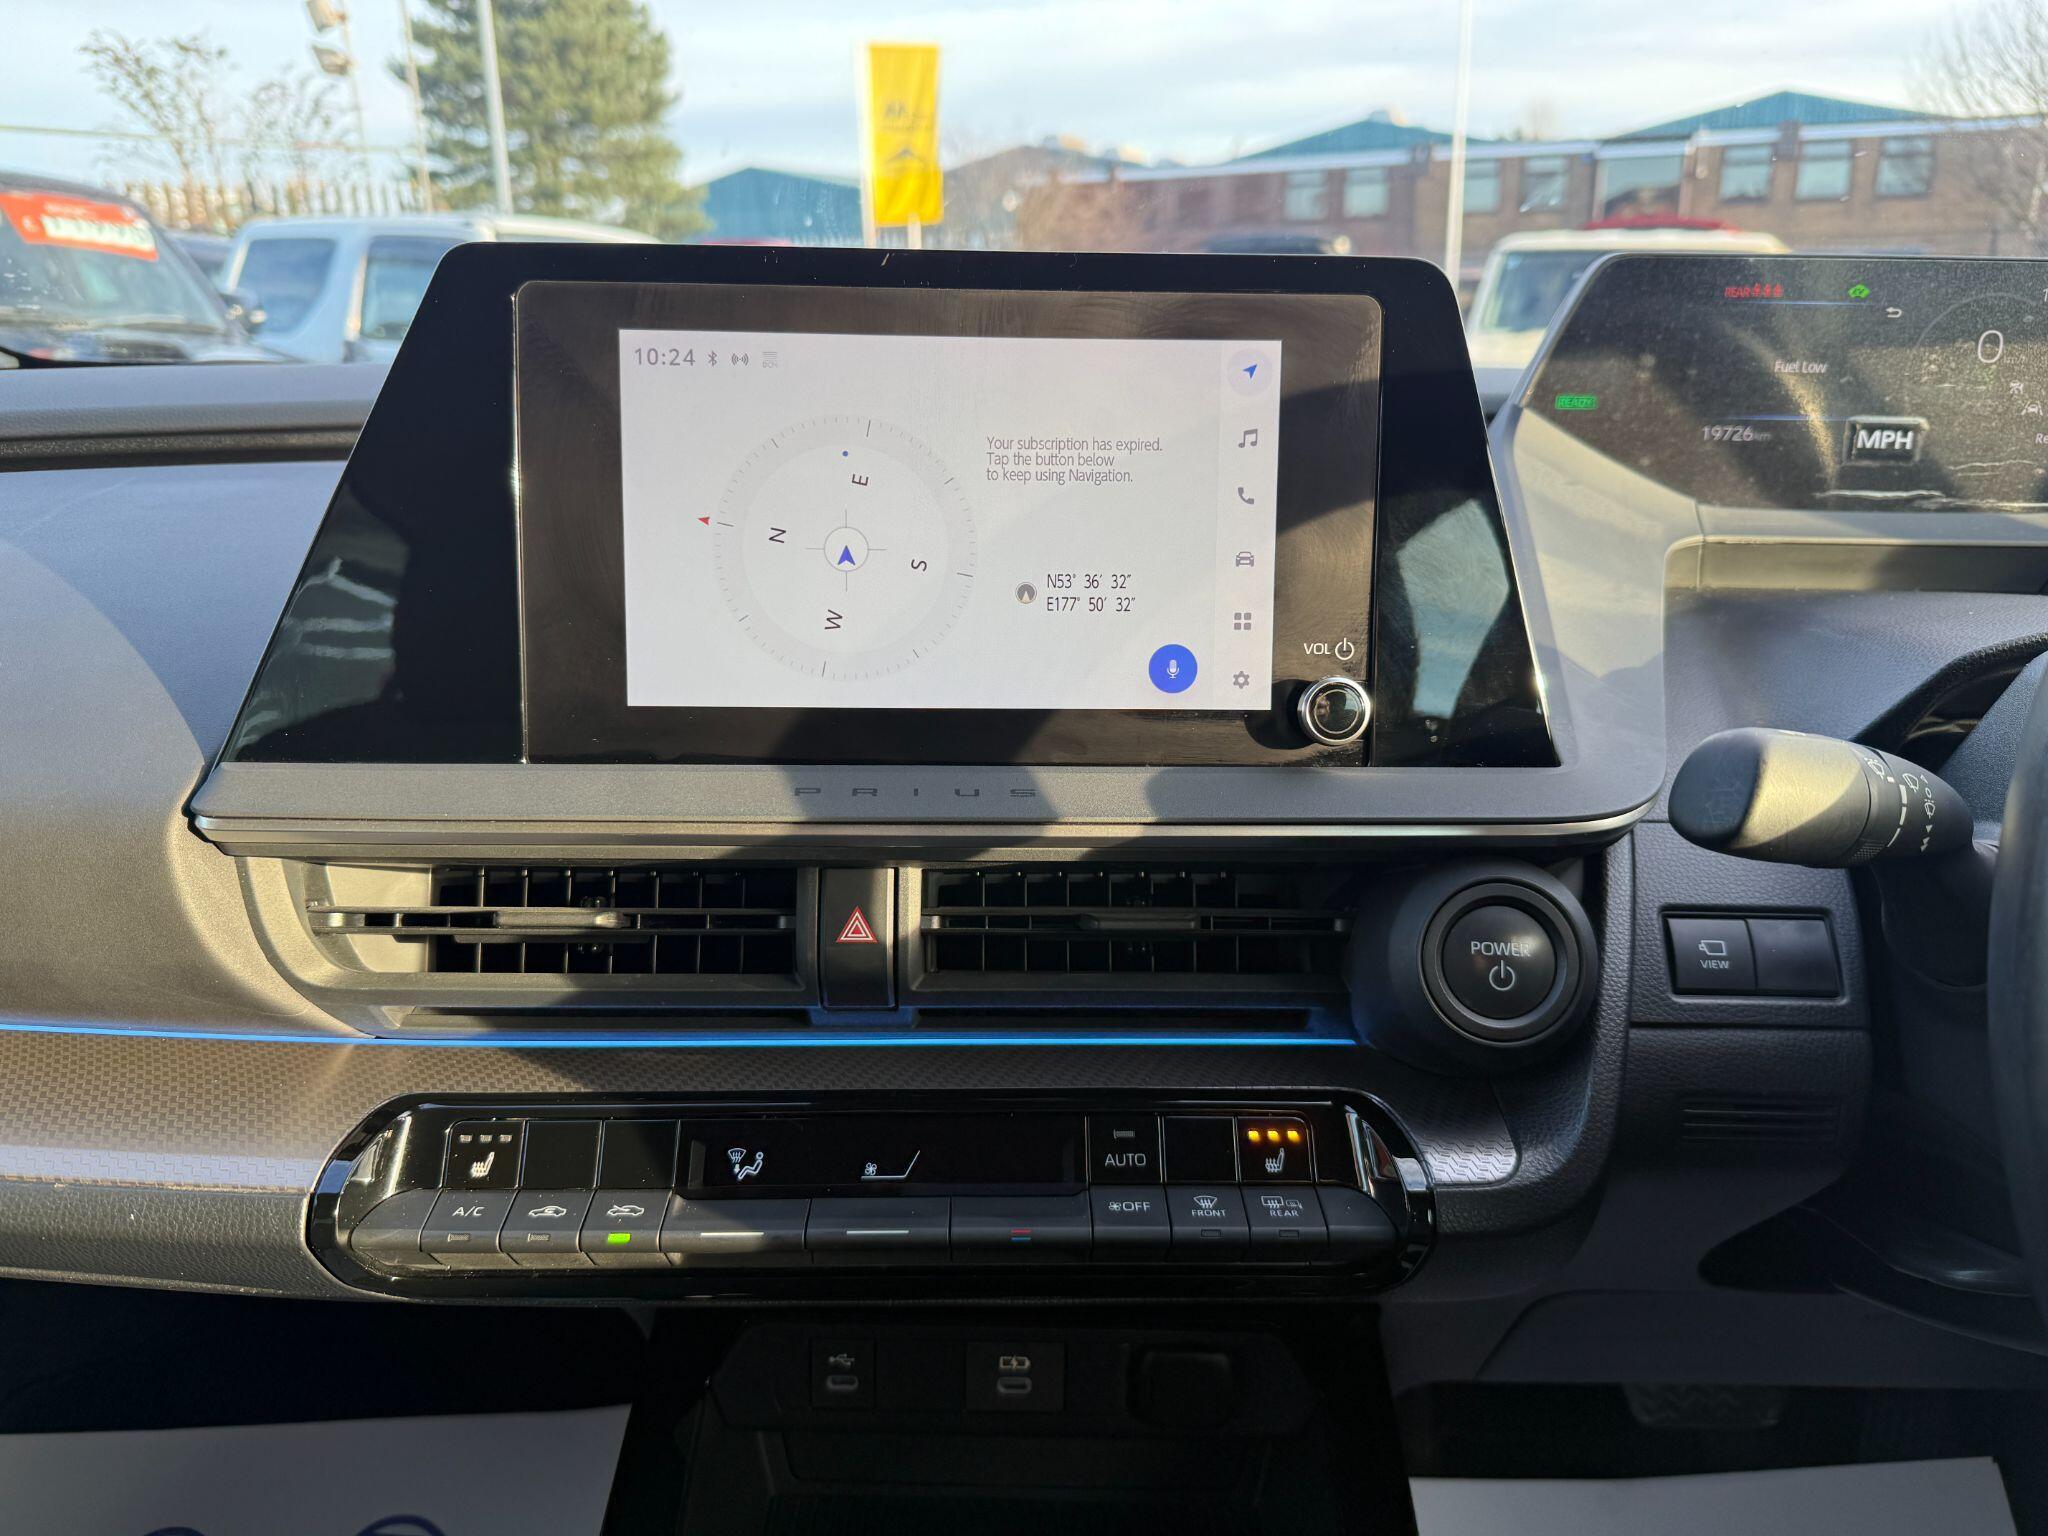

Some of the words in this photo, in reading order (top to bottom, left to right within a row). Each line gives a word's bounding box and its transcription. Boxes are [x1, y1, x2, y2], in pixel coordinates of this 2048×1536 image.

[1724, 286, 1750, 298] REAR
[1978, 330, 2003, 363] 0
[634, 348, 696, 366] 10:24
[1775, 360, 1800, 373] Fuel
[1801, 360, 1828, 373] Low
[986, 436, 1014, 451] Your
[1017, 437, 1088, 454] subscription
[1092, 437, 1112, 451] has
[1115, 438, 1162, 455] expired.
[1857, 429, 1914, 450] MPH
[986, 452, 1009, 469] Tap
[1013, 453, 1031, 466] the
[1035, 453, 1074, 466] button
[1077, 453, 1114, 466] below
[852, 474, 868, 486] E
[986, 468, 999, 481] to
[1003, 468, 1031, 484] keep
[1035, 469, 1065, 485] using
[1068, 469, 1133, 485] Navigation.
[769, 527, 786, 543] N
[911, 559, 927, 571] S
[825, 609, 843, 630] W
[1303, 643, 1331, 655] VOL
[794, 787, 1036, 797] PRIUS
[1471, 941, 1531, 957] POWER
[1700, 960, 1729, 969] VIEW
[1105, 1153, 1147, 1167] AUTO
[452, 1206, 485, 1216] A/C
[1122, 1201, 1150, 1212] OFF
[1191, 1209, 1226, 1217] FRONT
[1269, 1209, 1299, 1217] REAR
